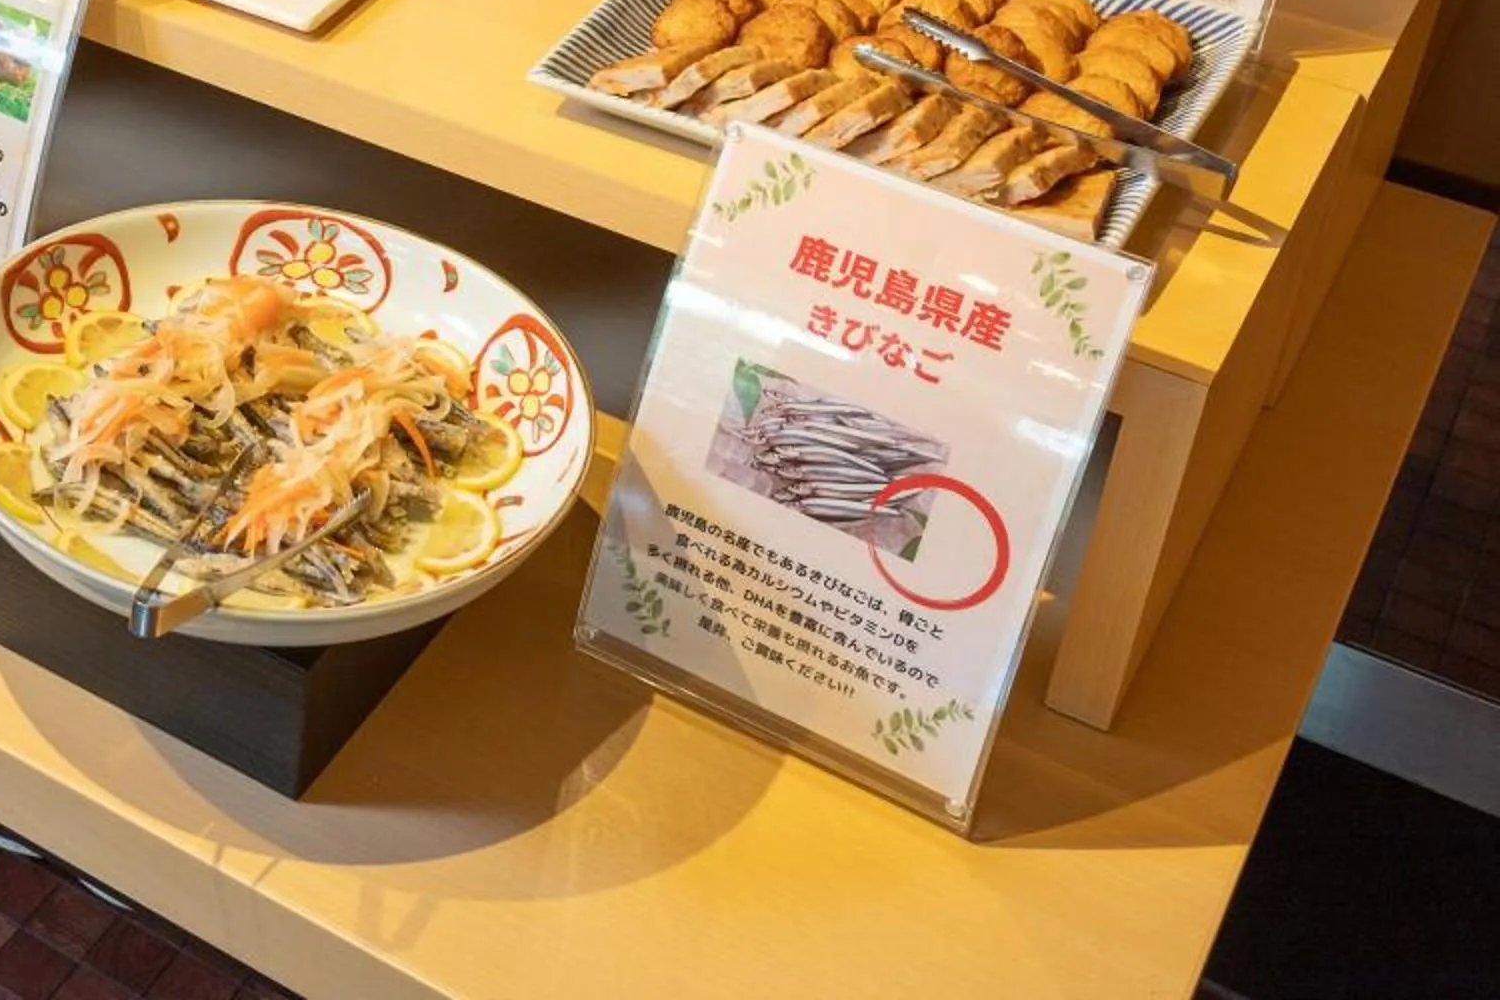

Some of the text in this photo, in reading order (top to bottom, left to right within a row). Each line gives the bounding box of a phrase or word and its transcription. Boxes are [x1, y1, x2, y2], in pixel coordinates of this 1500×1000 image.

[789, 235, 1013, 352] 鹿児島県産
[806, 303, 955, 385] きびなご
[665, 503, 947, 641] 鹿児島の名産でもあるきびなごは、骨ごと
